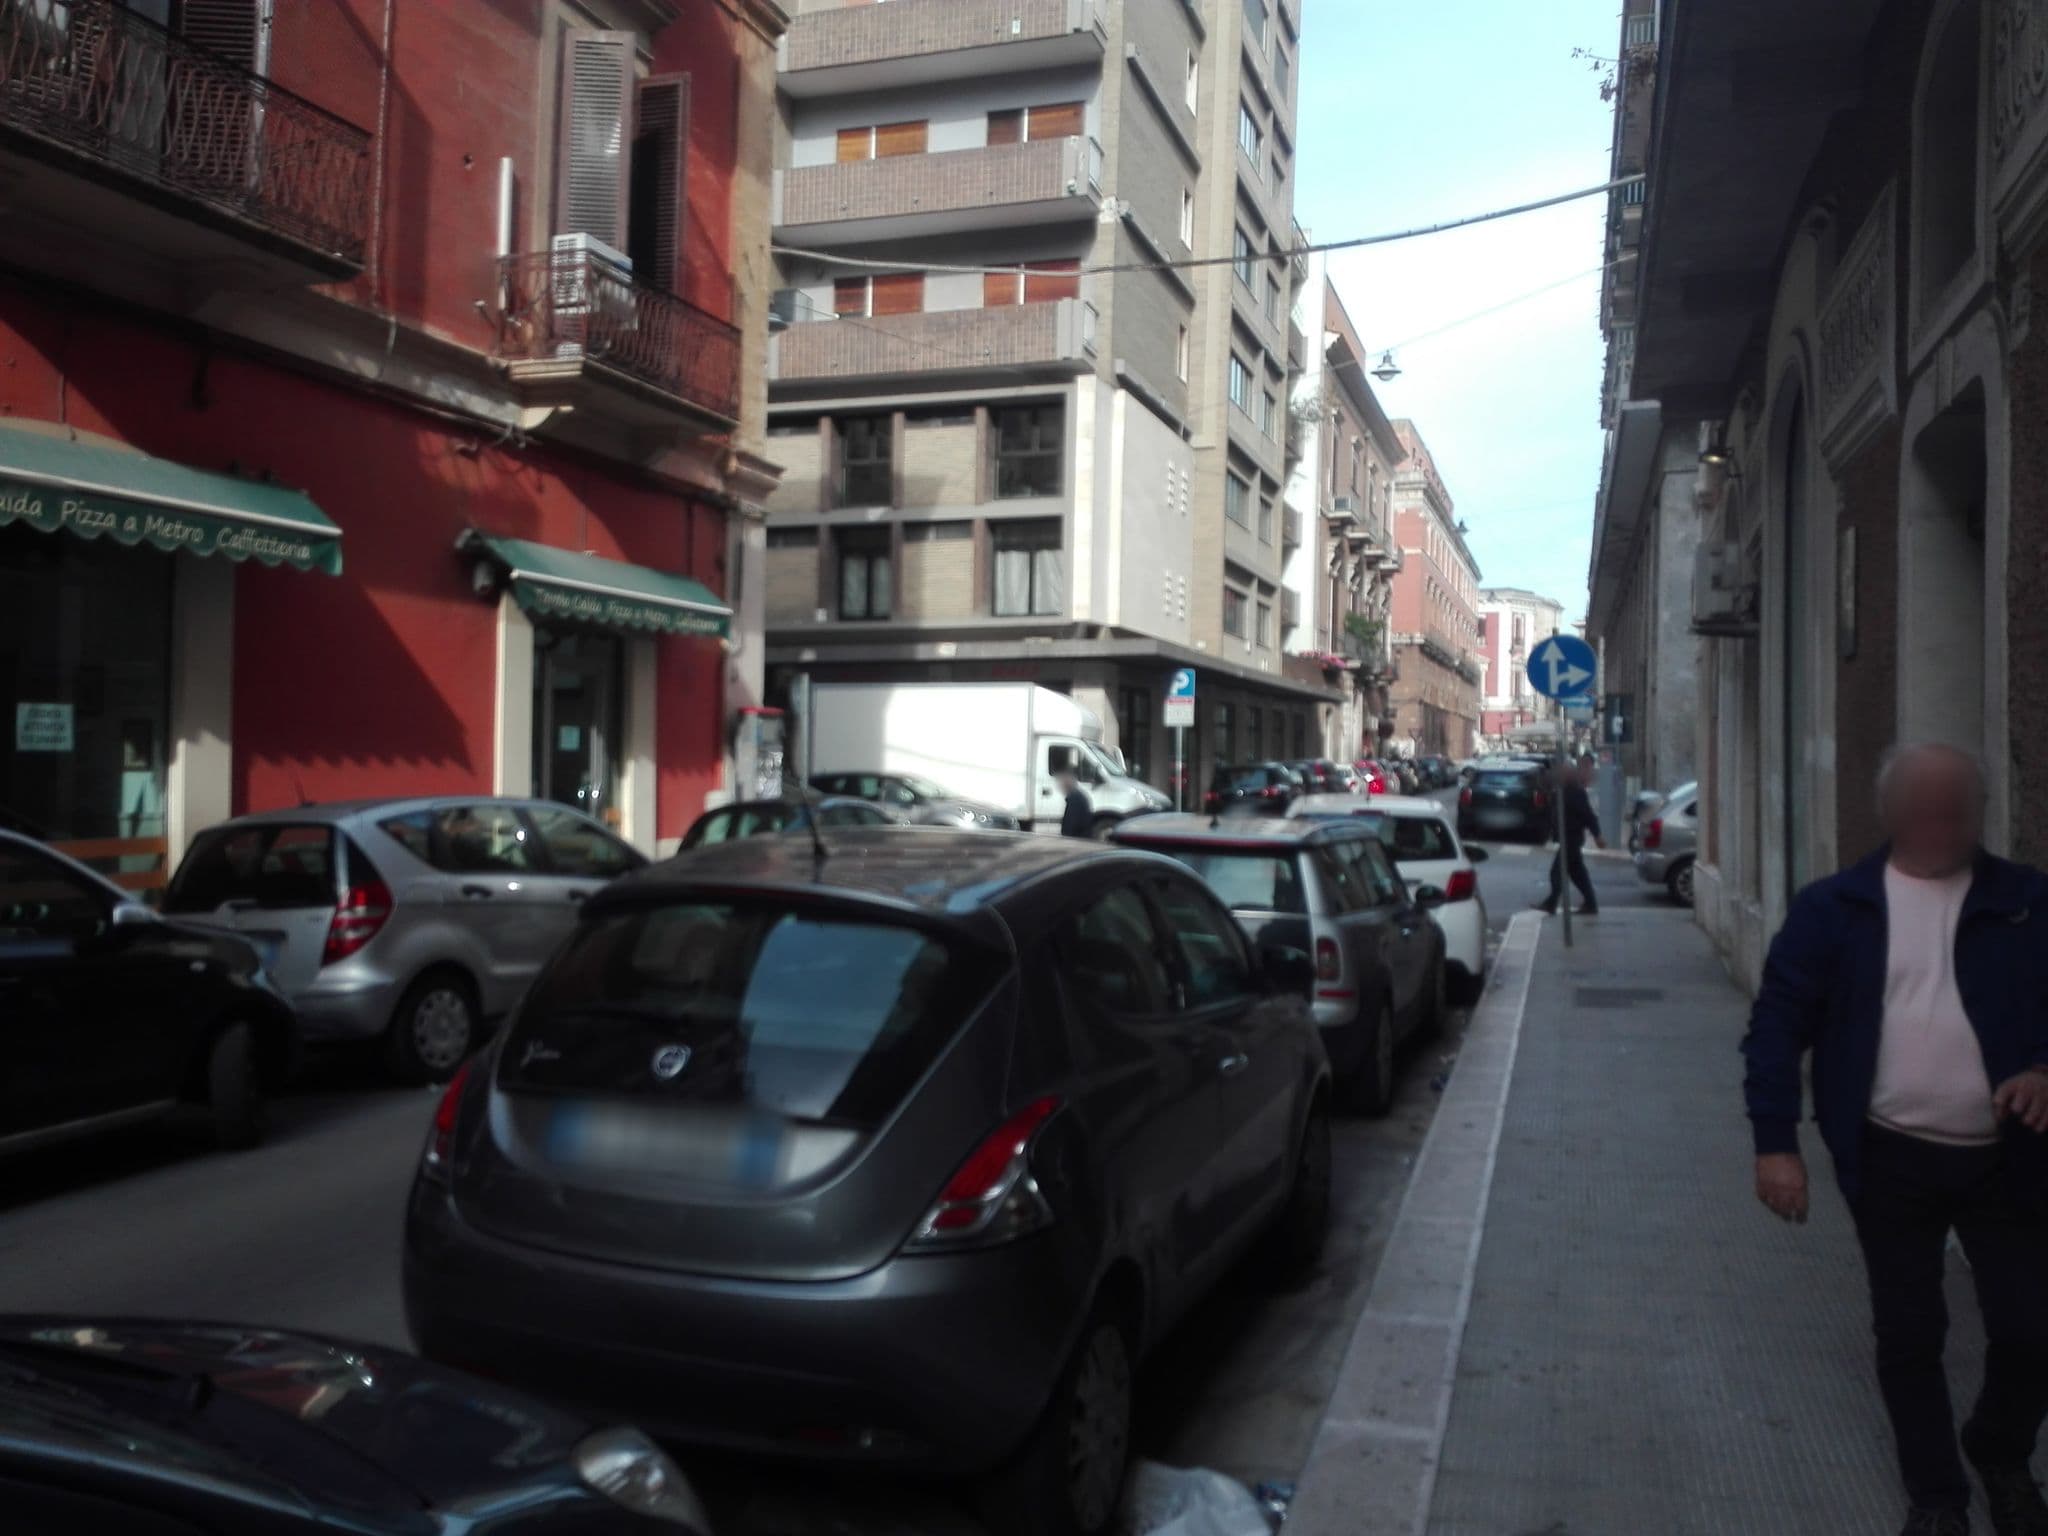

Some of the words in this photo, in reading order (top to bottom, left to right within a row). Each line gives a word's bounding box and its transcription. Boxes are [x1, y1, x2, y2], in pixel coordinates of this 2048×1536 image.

[60, 500, 117, 529] Pizza
[123, 515, 137, 532] a
[144, 514, 205, 544] Metro
